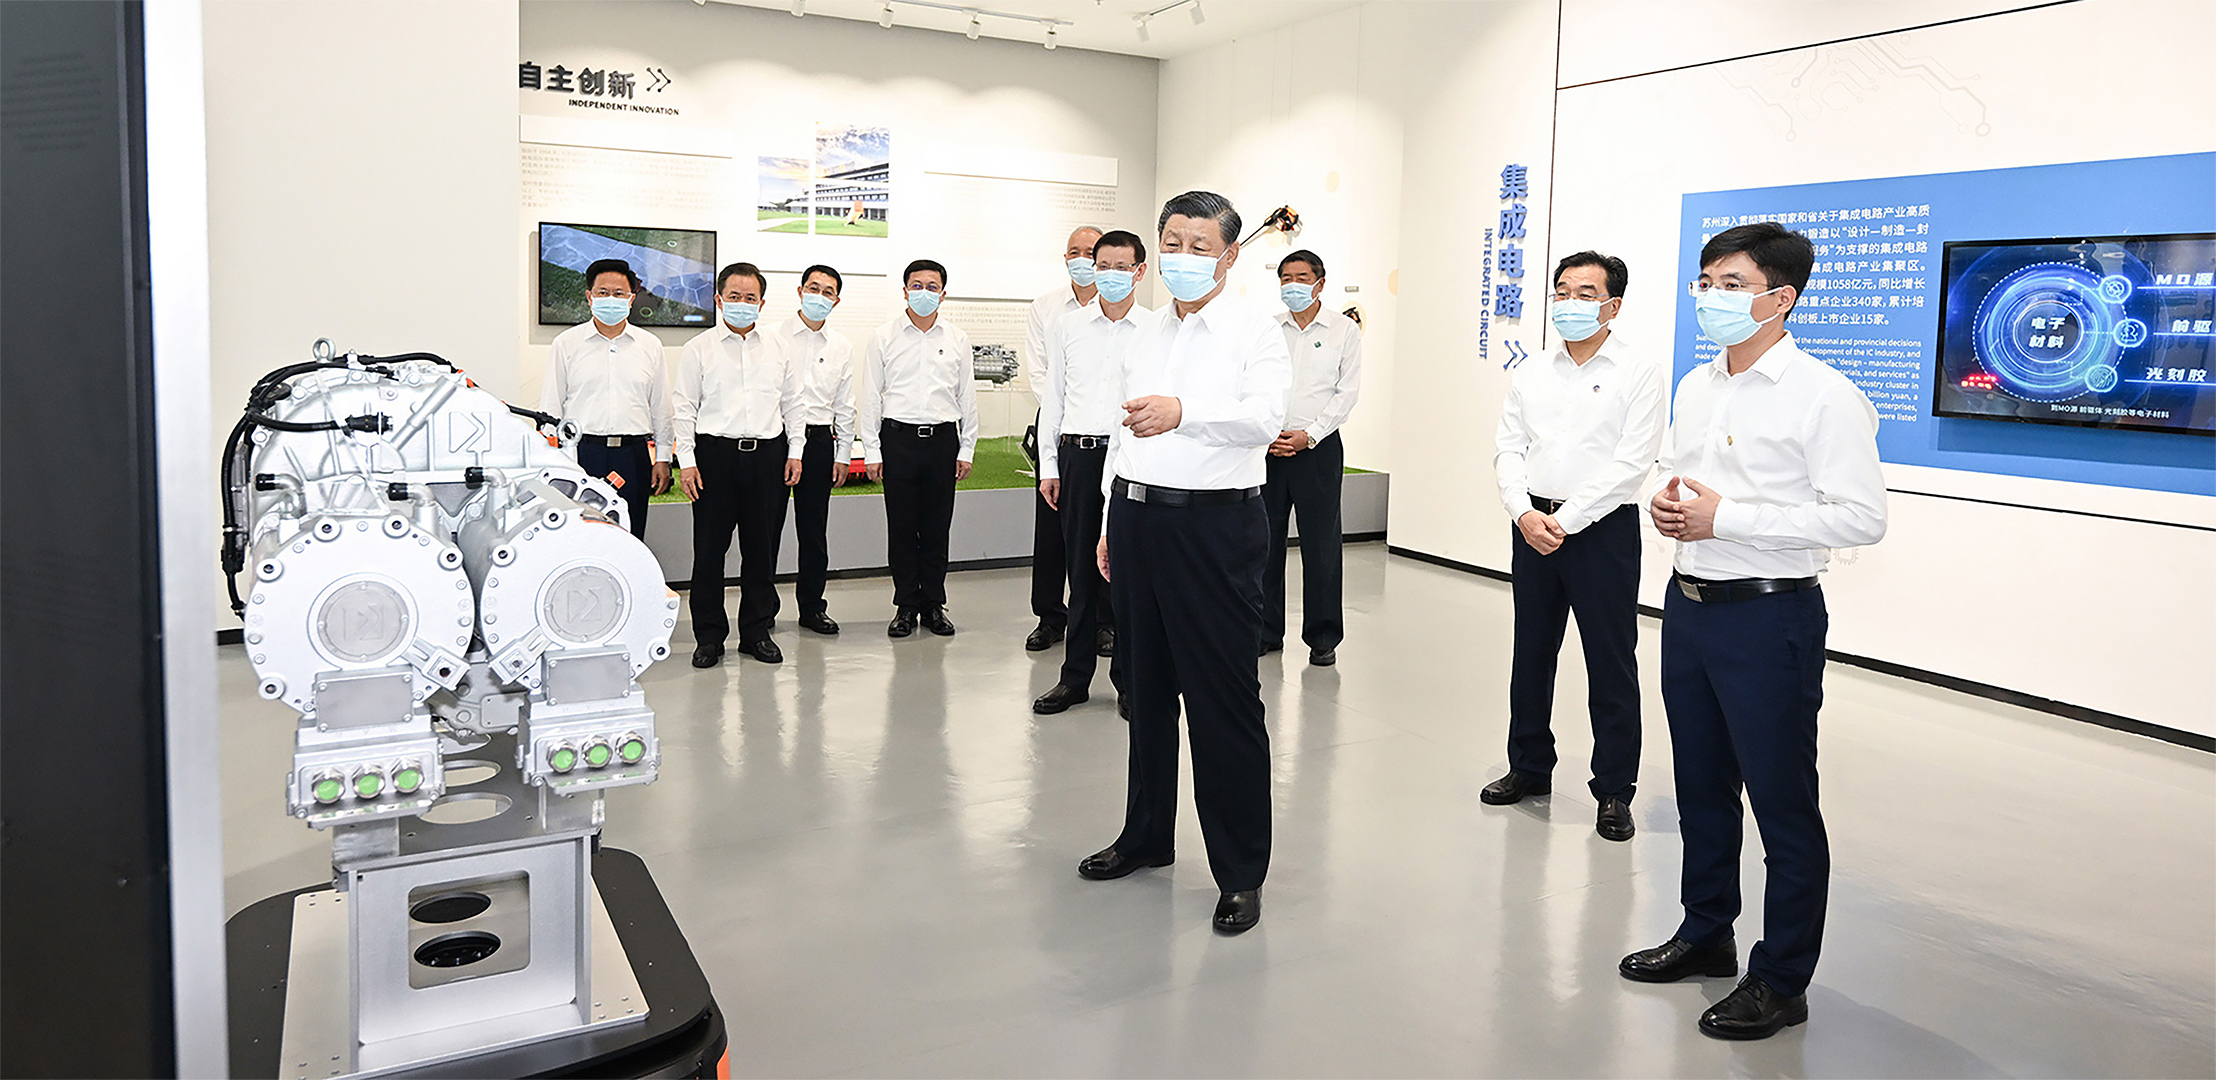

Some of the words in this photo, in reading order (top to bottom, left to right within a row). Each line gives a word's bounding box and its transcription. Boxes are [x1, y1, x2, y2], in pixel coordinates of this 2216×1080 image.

[519, 61, 636, 100] 自主创新
[568, 98, 628, 112] INDEPENDENT
[629, 104, 680, 116] INNOVATION
[1494, 163, 1528, 320] 集成电路
[1481, 228, 1493, 306] INTEGRATED
[1810, 259, 1926, 274] 集成电路产业集聚区。
[1795, 295, 1925, 308] 路重点企业340家，累计培
[1787, 313, 1889, 325] 科创板上市企业15家。
[2031, 316, 2065, 330] 电子
[2172, 319, 2216, 333] 前驱
[1479, 309, 1490, 360] CIRCUIT
[1812, 337, 1839, 345] national
[1840, 338, 1852, 346] and
[1853, 338, 1887, 348] provincial
[1888, 338, 1921, 347] decisions
[2029, 335, 2064, 349] 材料
[1845, 348, 1853, 356] of
[1853, 348, 1865, 356] the
[1874, 349, 1905, 359] industry,
[1907, 350, 1921, 358] and
[1868, 360, 1920, 371] manufacturing
[1864, 370, 1877, 378] and
[2146, 367, 2208, 382] 光刻胶
[1885, 381, 1909, 389] cluster
[1867, 390, 1890, 398] billion
[1891, 393, 1911, 401] yuan,
[1897, 413, 1917, 422] listed
